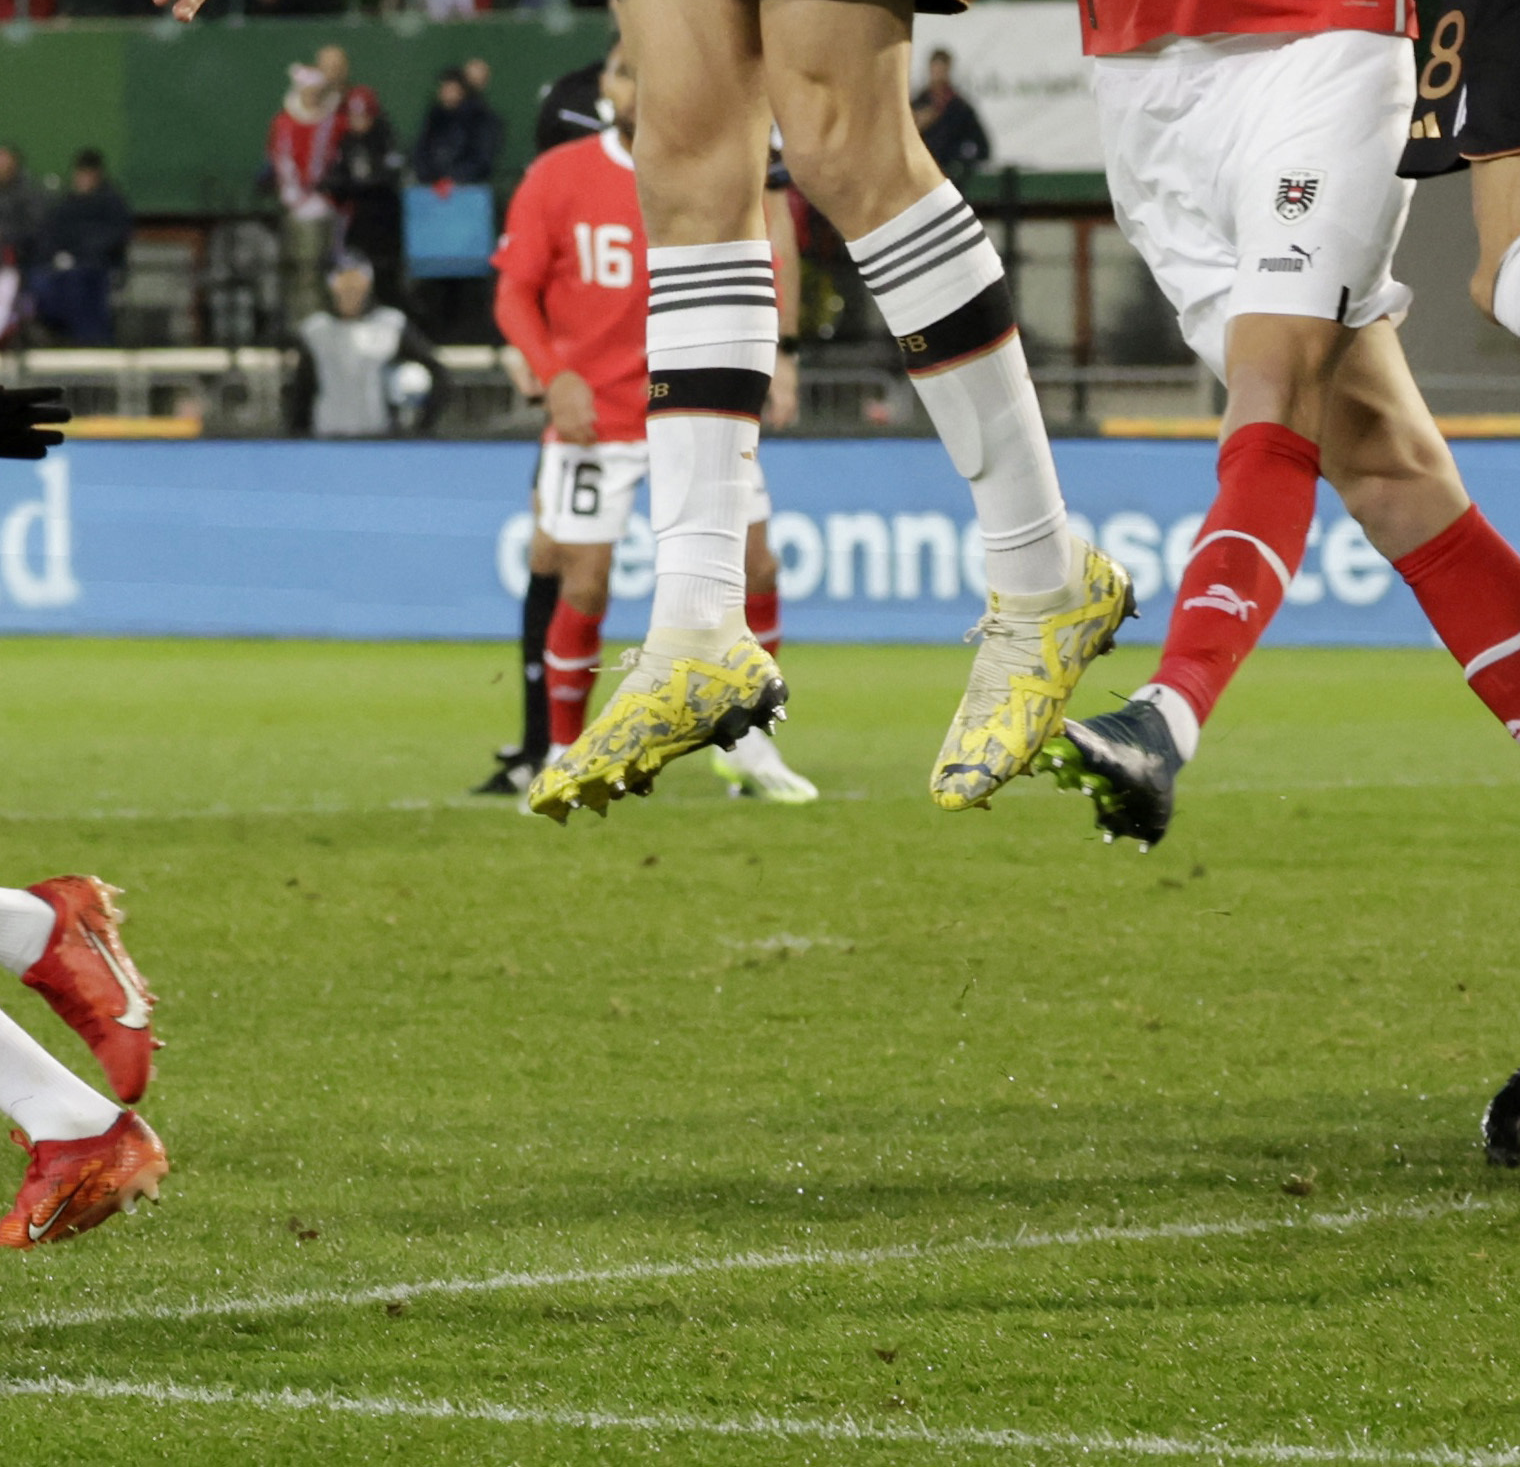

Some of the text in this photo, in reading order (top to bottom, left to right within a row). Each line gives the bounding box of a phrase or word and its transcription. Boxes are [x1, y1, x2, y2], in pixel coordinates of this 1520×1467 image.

[1419, 9, 1466, 100] 8
[573, 221, 633, 289] 16
[557, 458, 604, 518] 16
